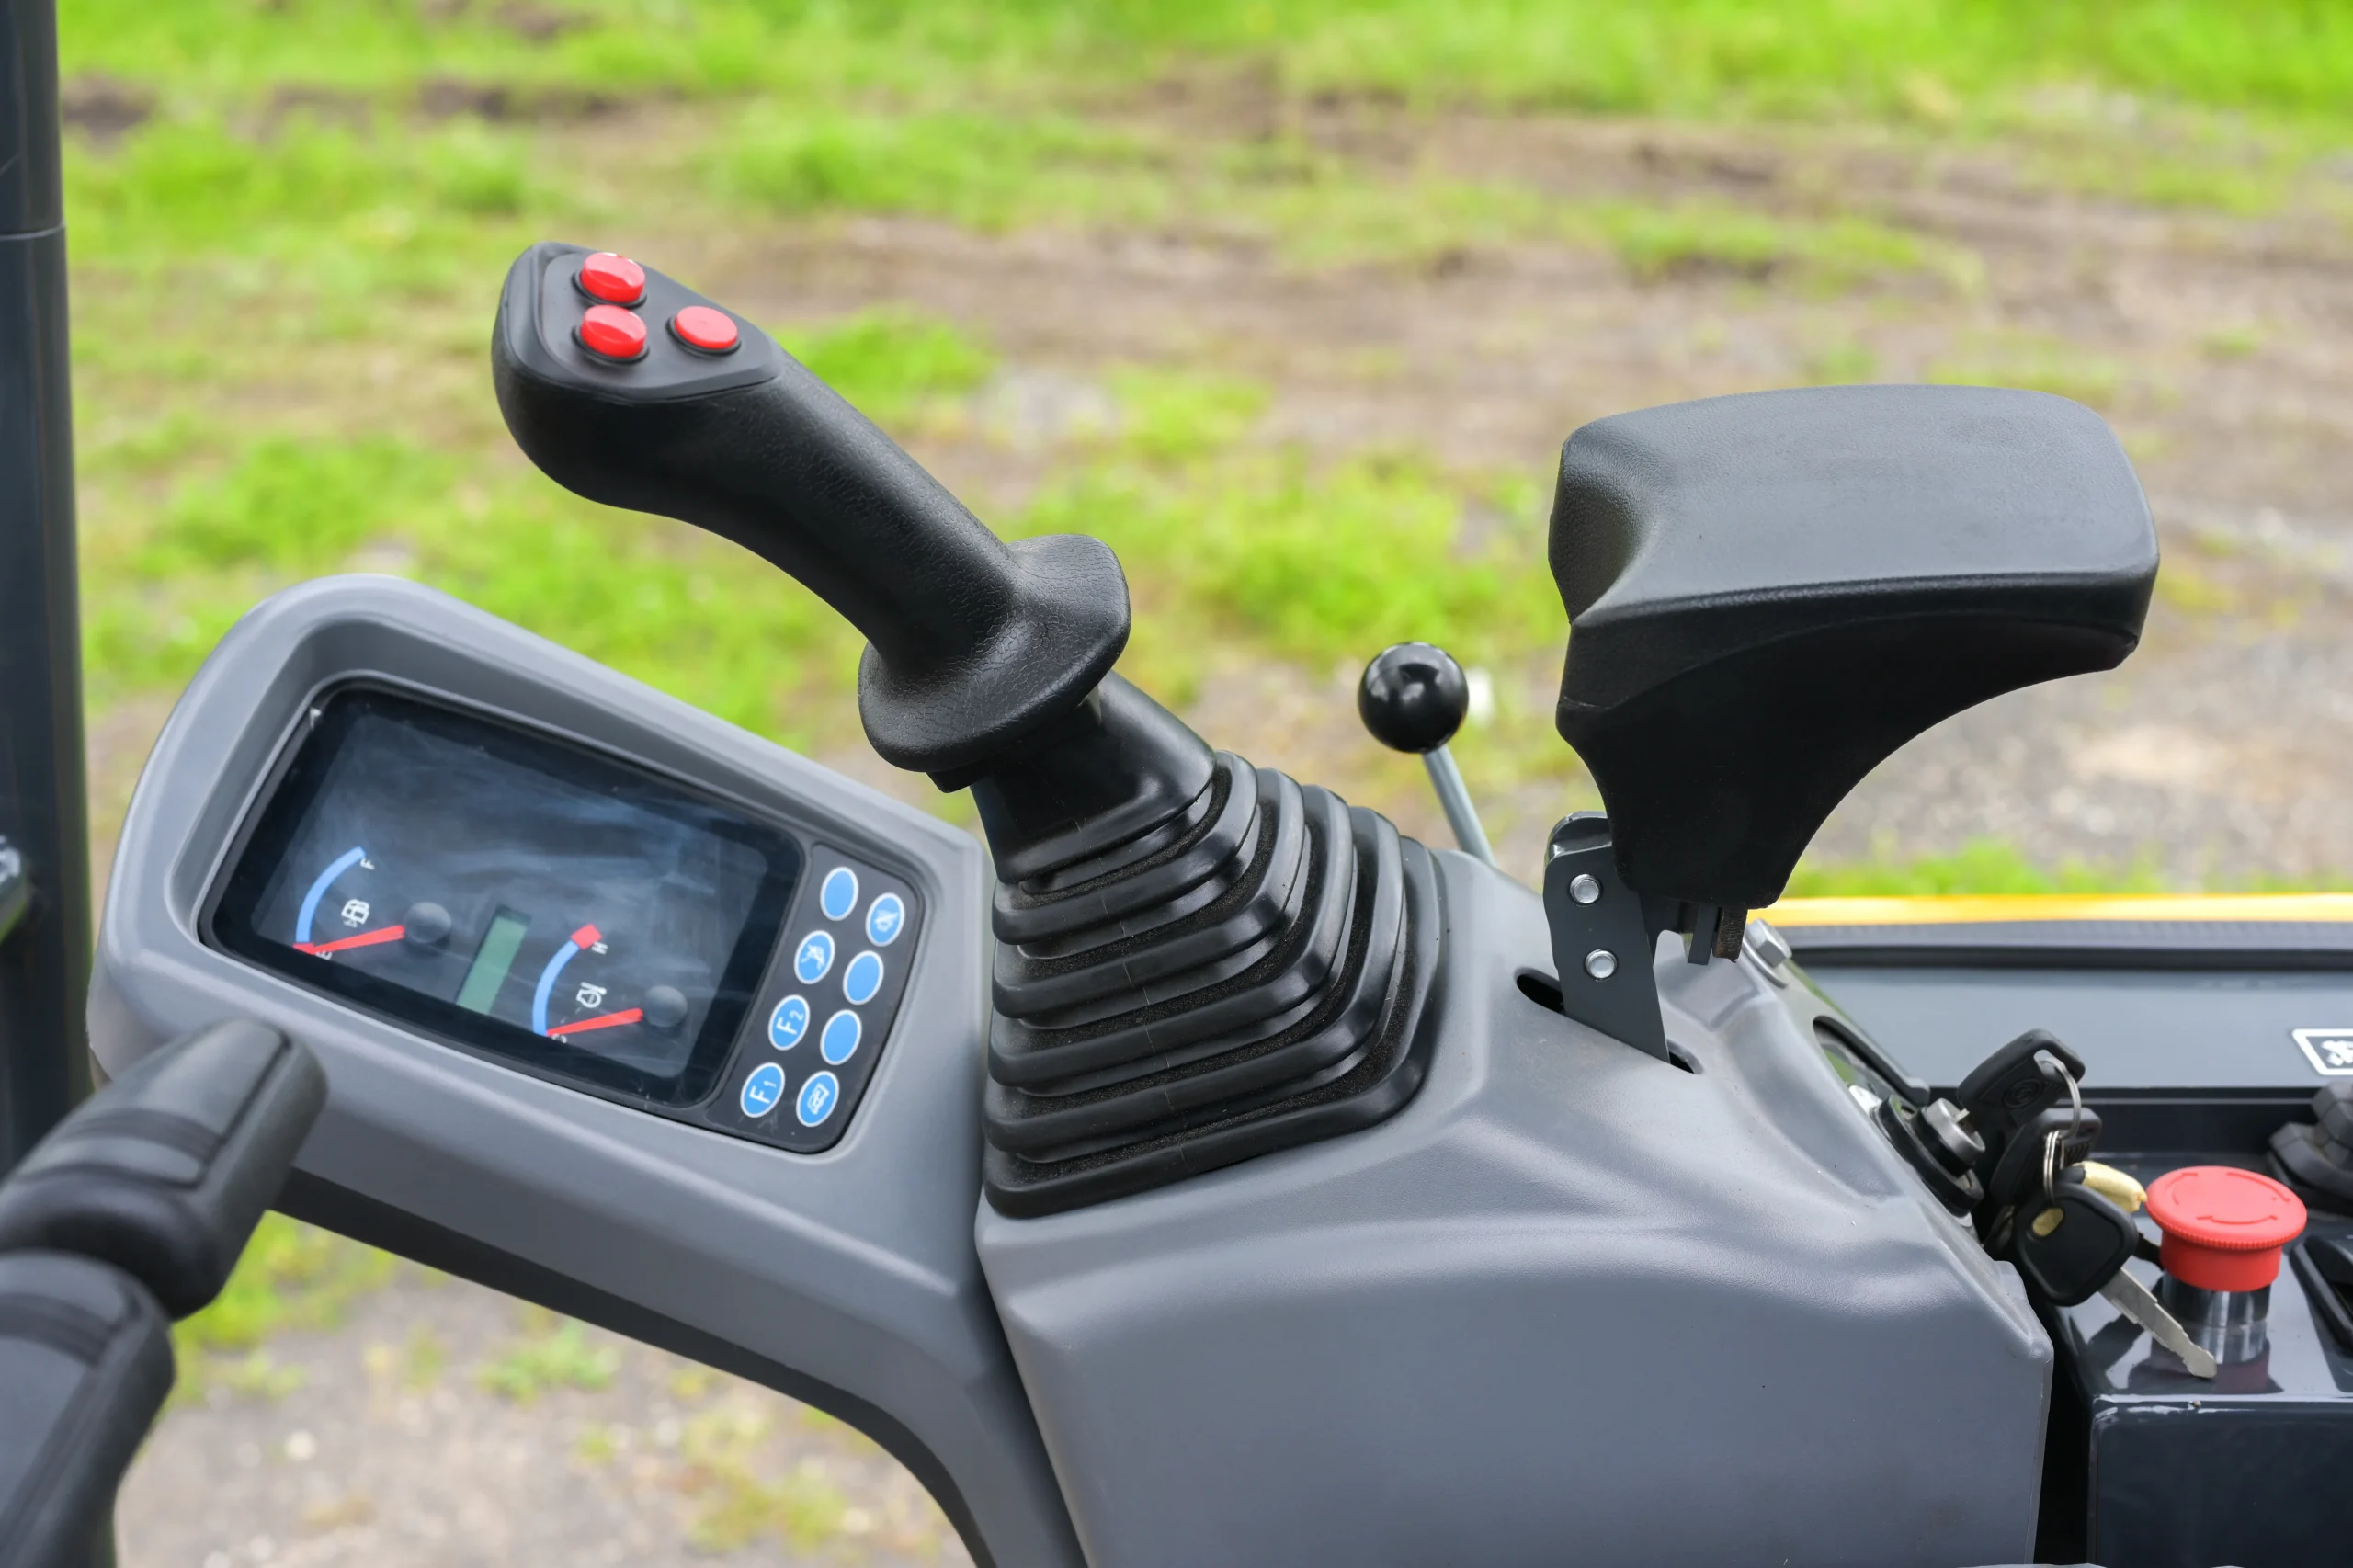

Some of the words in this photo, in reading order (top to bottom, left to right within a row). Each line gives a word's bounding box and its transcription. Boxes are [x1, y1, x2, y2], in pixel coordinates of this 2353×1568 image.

[360, 858, 375, 870] F
[591, 941, 608, 955] H
[776, 1010, 804, 1035] F2
[749, 1080, 777, 1103] F1
